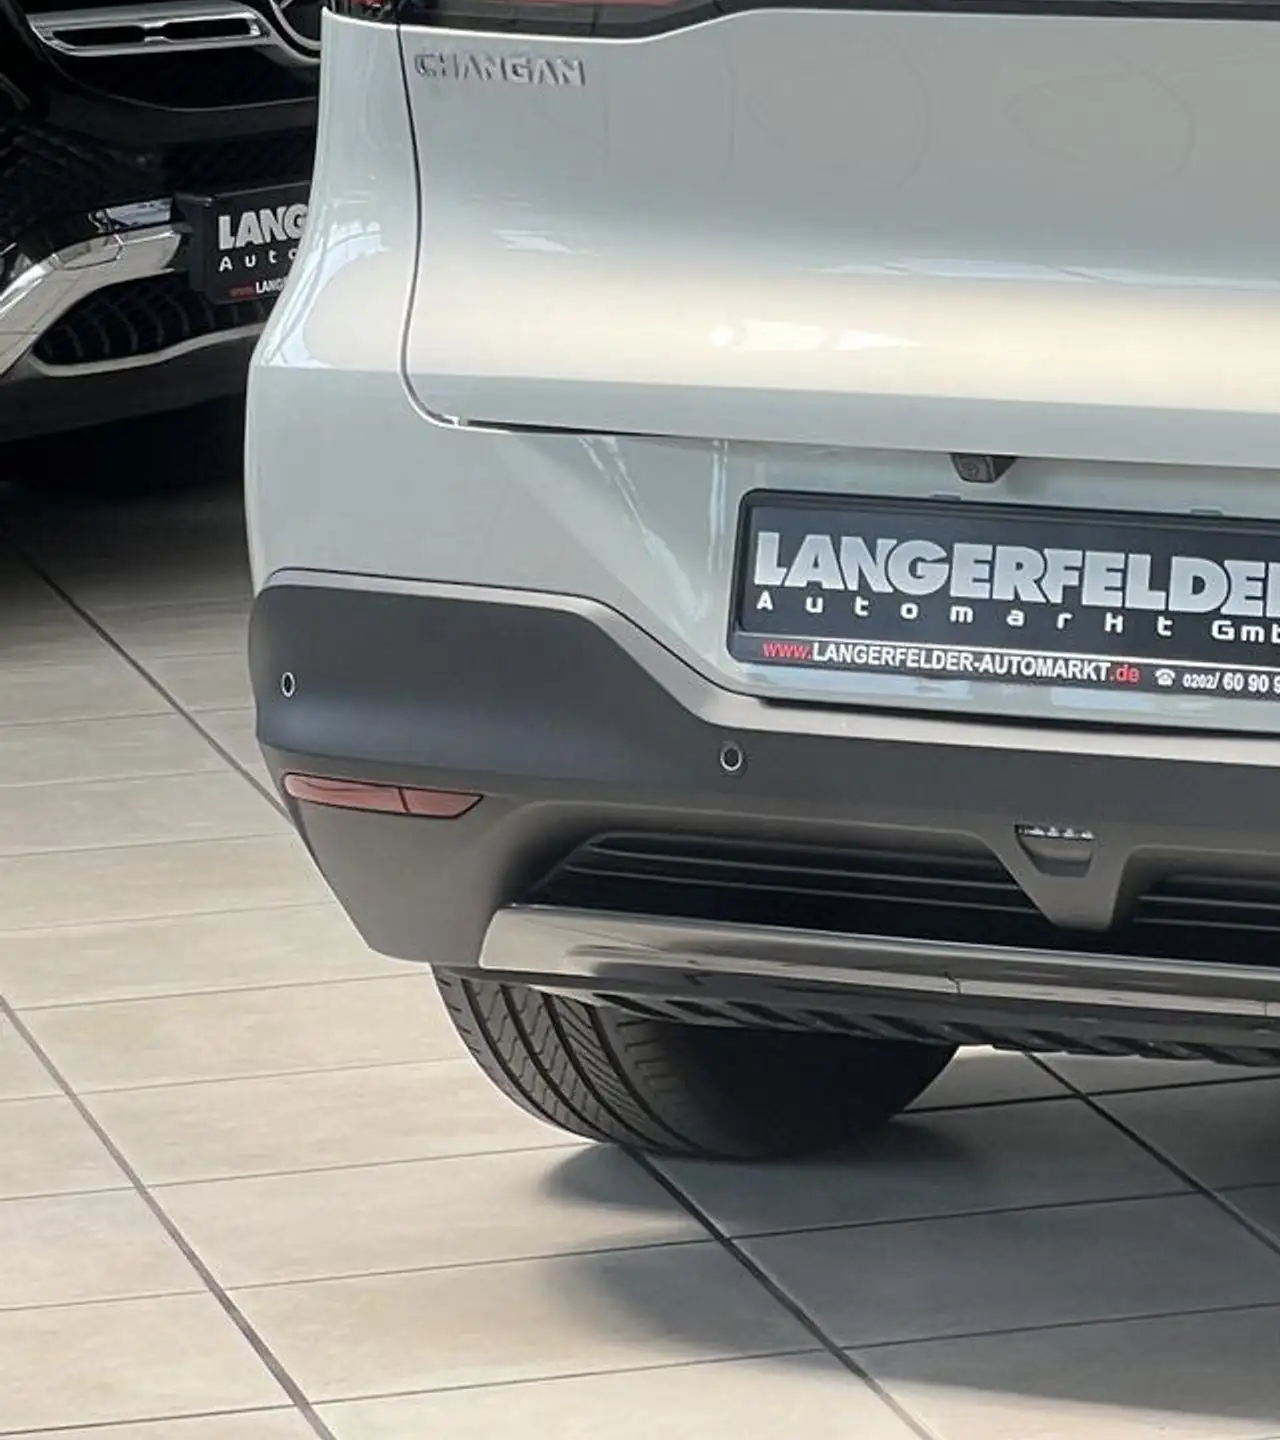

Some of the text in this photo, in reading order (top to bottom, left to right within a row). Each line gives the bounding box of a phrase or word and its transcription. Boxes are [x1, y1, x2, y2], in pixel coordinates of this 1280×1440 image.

[414, 50, 587, 87] CHANGAN
[762, 640, 1140, 683] www.LANGERFELDER-AUTOMARKT.de
[1222, 672, 1245, 692] 60
[1247, 674, 1270, 694] 90
